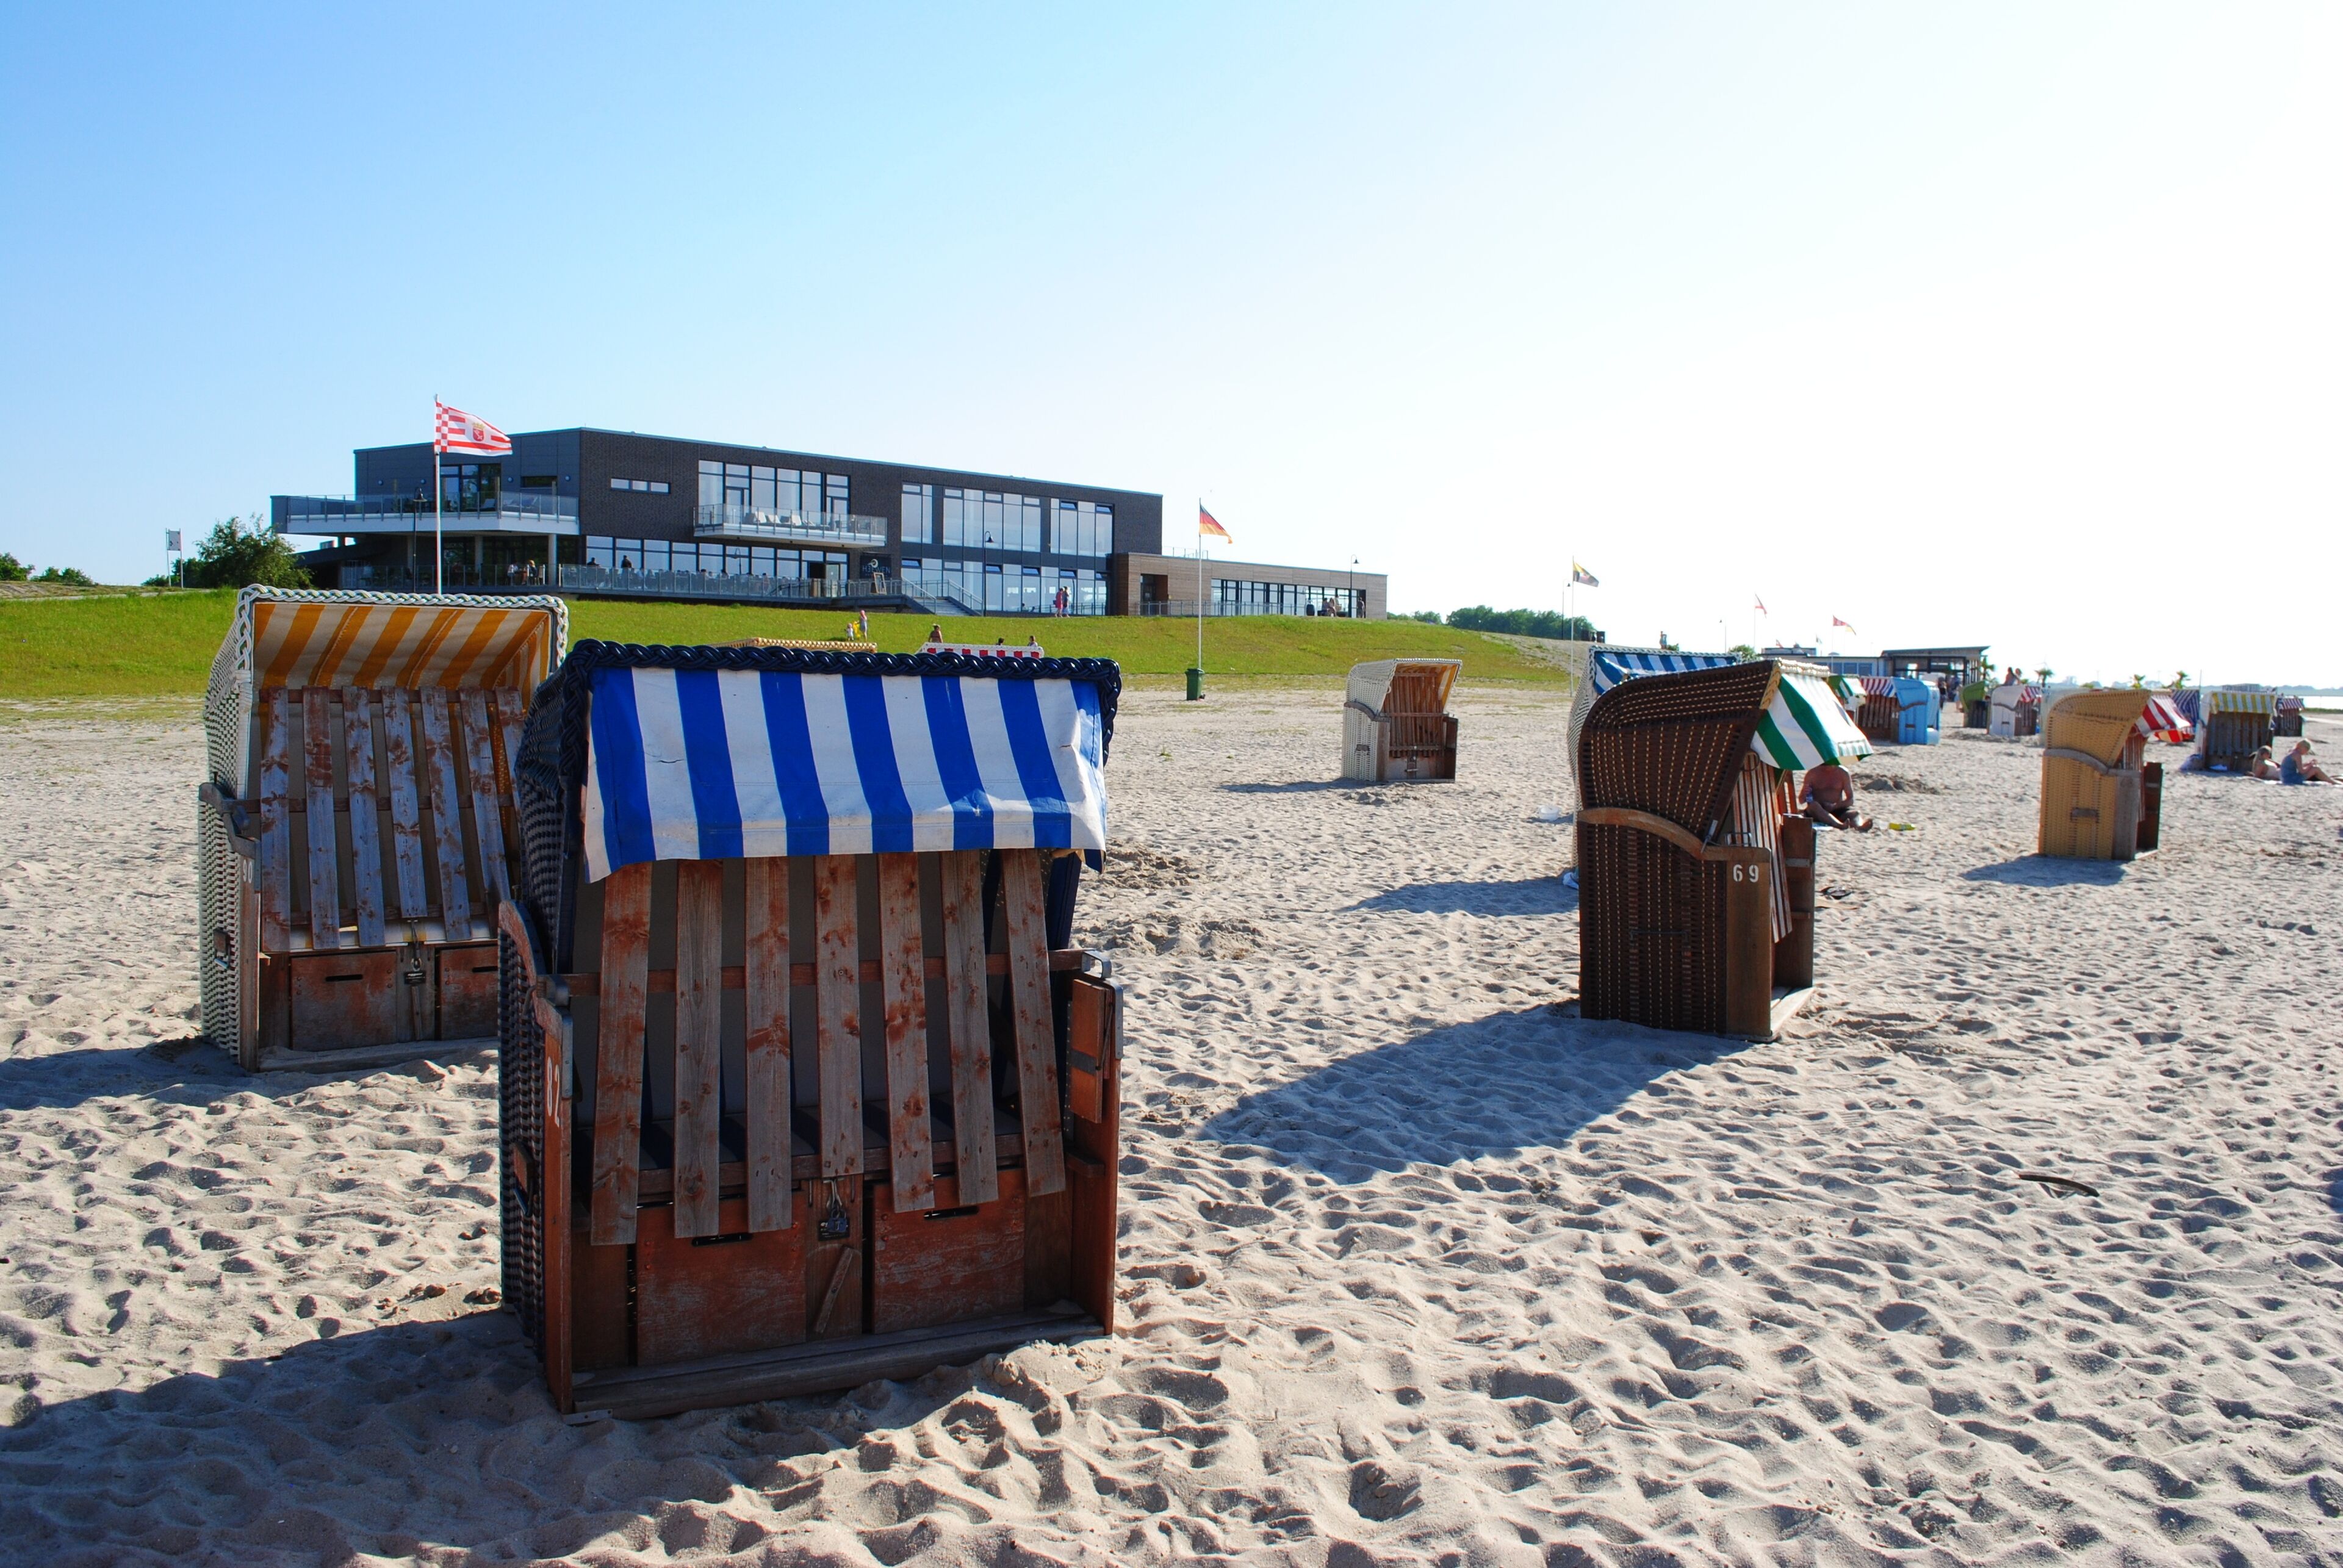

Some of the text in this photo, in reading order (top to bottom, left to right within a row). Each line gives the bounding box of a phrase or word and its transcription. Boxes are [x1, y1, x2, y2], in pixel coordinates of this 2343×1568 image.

[243, 859, 253, 884] 90
[1733, 864, 1758, 883] 69
[547, 1056, 560, 1128] 82
